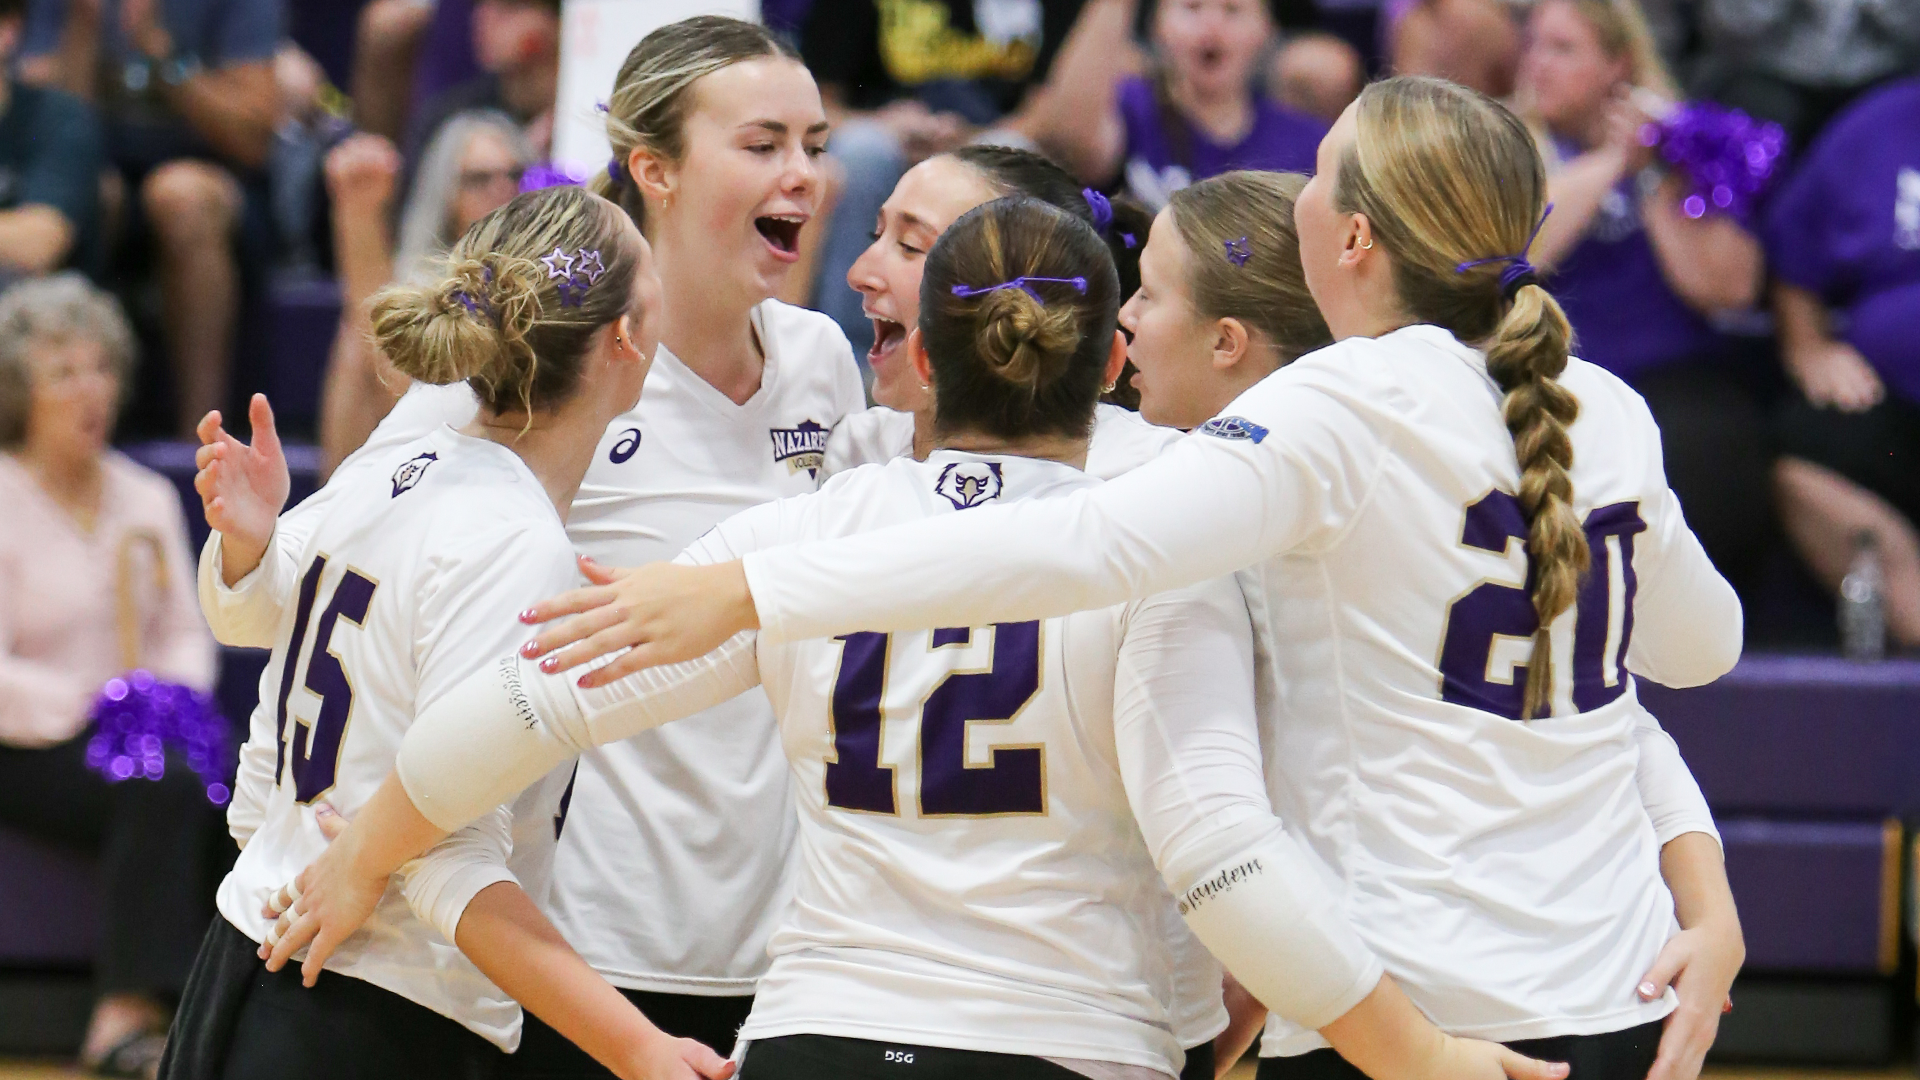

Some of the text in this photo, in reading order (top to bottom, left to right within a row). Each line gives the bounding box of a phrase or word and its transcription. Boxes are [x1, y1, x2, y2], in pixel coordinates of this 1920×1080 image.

[772, 430, 829, 459] NAZARE
[275, 550, 380, 806] 15
[1434, 487, 1648, 720] 20
[822, 618, 1049, 819] 12
[884, 1050, 915, 1064] DSG
